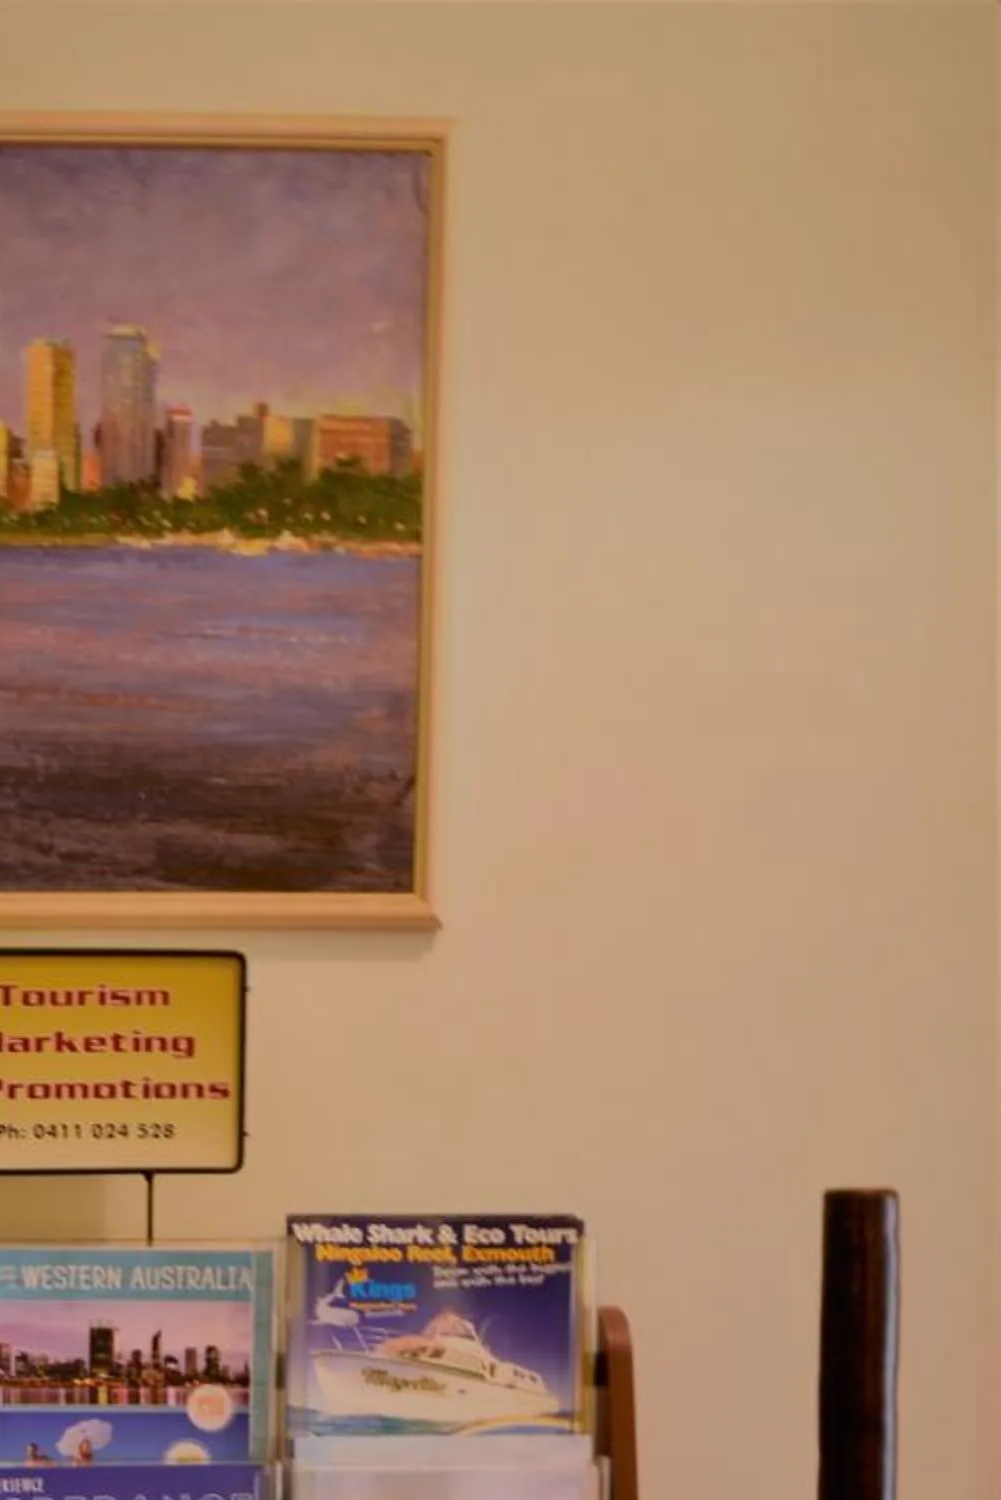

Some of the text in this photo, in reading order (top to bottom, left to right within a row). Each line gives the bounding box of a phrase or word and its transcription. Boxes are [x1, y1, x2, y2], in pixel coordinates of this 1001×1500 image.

[34, 1124, 84, 1140] 0411
[91, 1124, 130, 1140] 024
[137, 1124, 175, 1140] 528
[293, 1223, 579, 1244] Whale Shark & Eco Tours
[21, 1265, 122, 1290] WESTERN
[131, 1265, 254, 1291] AUSTRALIA
